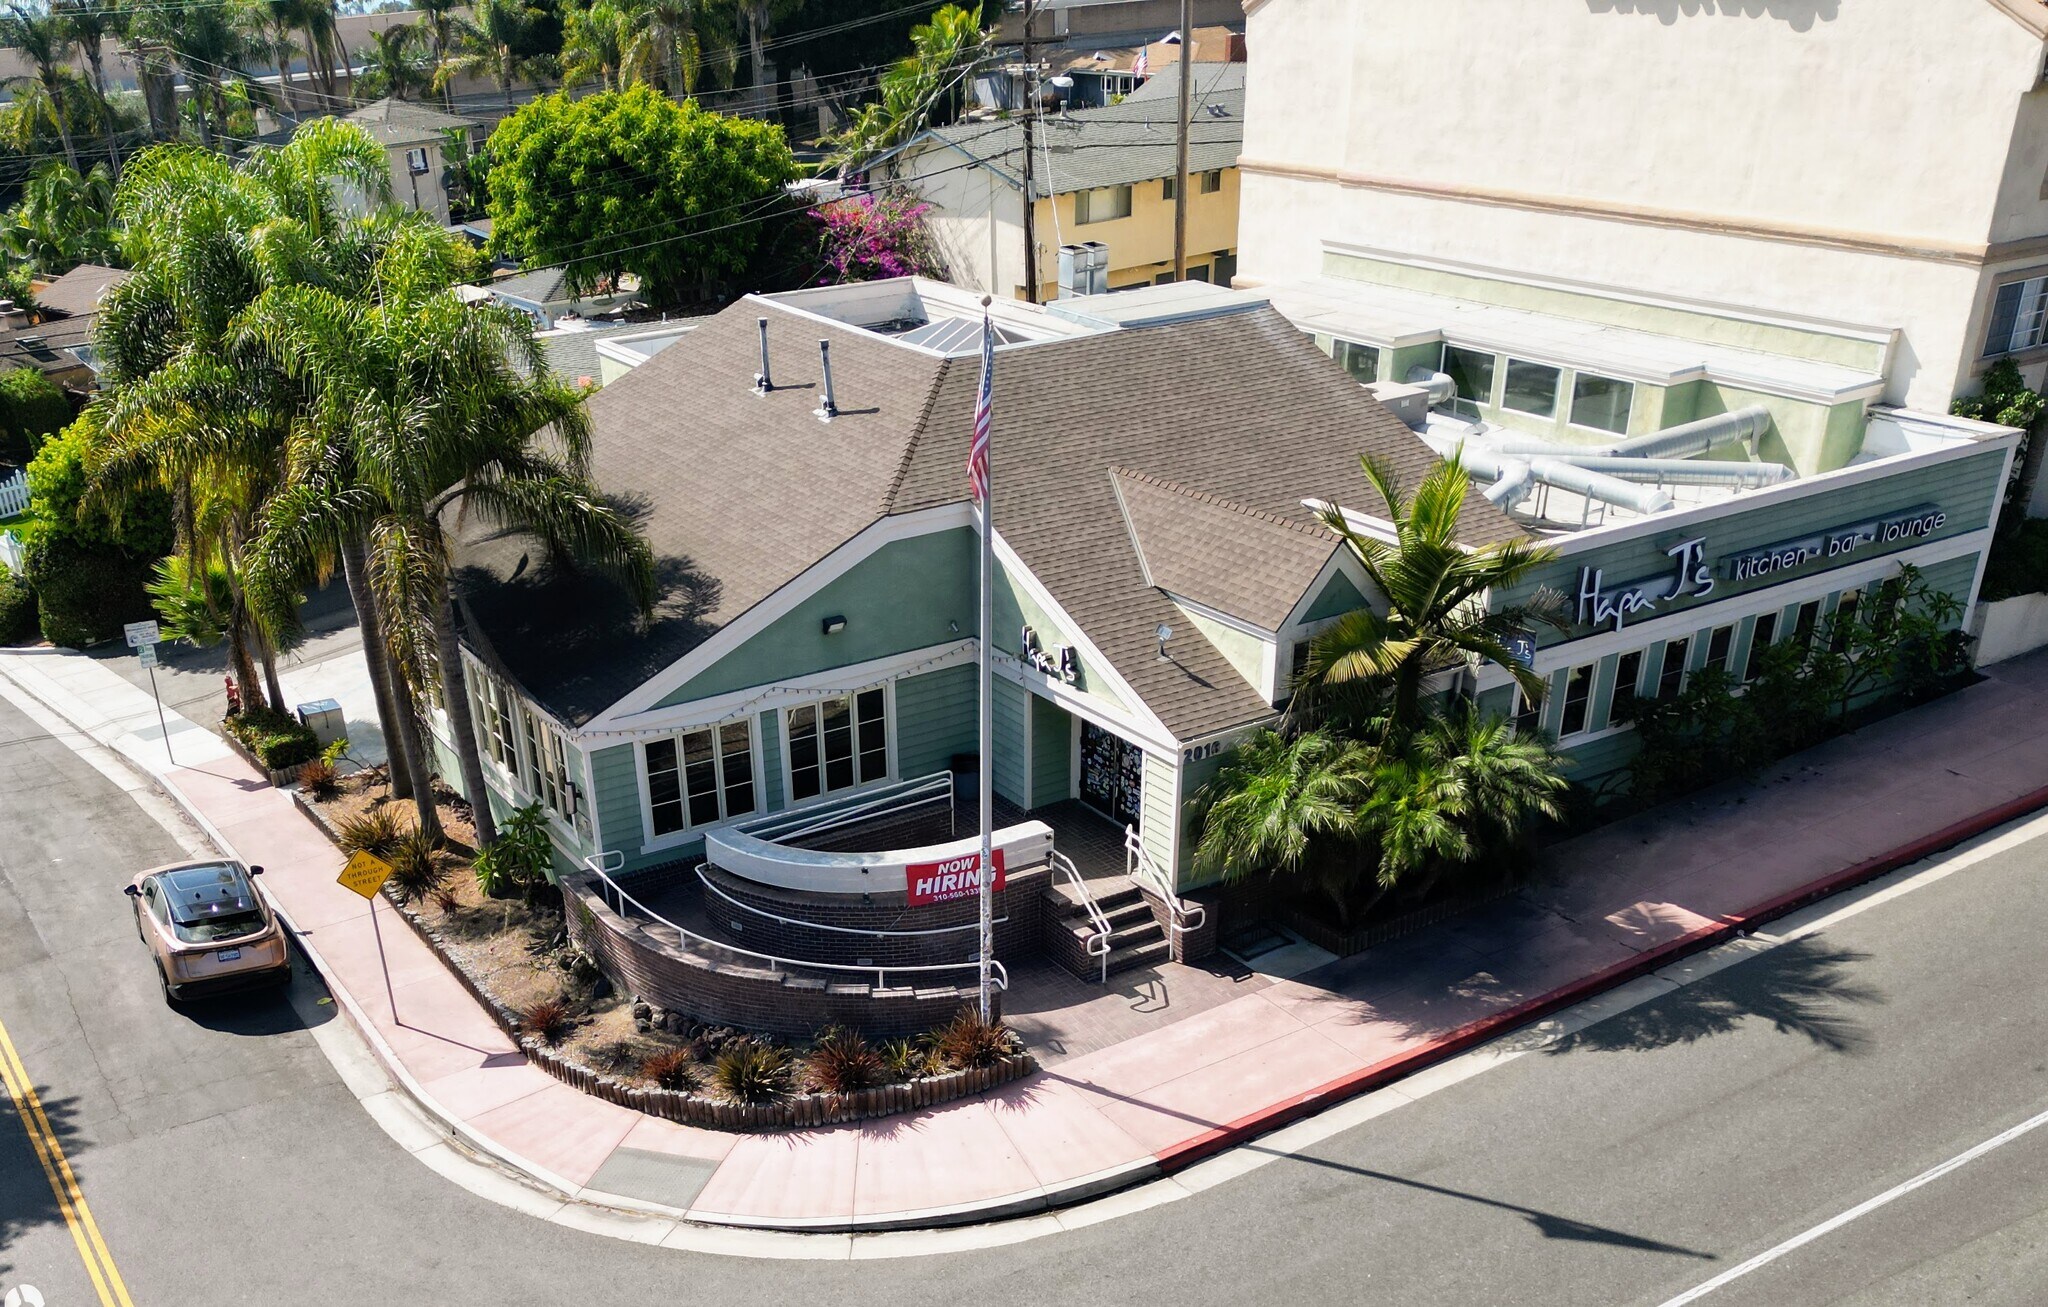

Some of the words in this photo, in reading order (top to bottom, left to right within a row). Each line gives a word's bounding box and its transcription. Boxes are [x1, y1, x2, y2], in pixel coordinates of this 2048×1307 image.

[1735, 549, 1807, 581] kitchen
[1827, 533, 1863, 557] bar
[1881, 512, 1946, 544] lounge
[1577, 566, 1656, 632] Hapa
[1664, 536, 1715, 599] J's
[1022, 626, 1052, 672] Hapa
[1052, 643, 1075, 682] J's
[1516, 640, 1532, 659] J's
[347, 866, 384, 879] THROUGH
[352, 861, 366, 870] NOT
[937, 856, 975, 875] NOW
[353, 875, 381, 887] STREET
